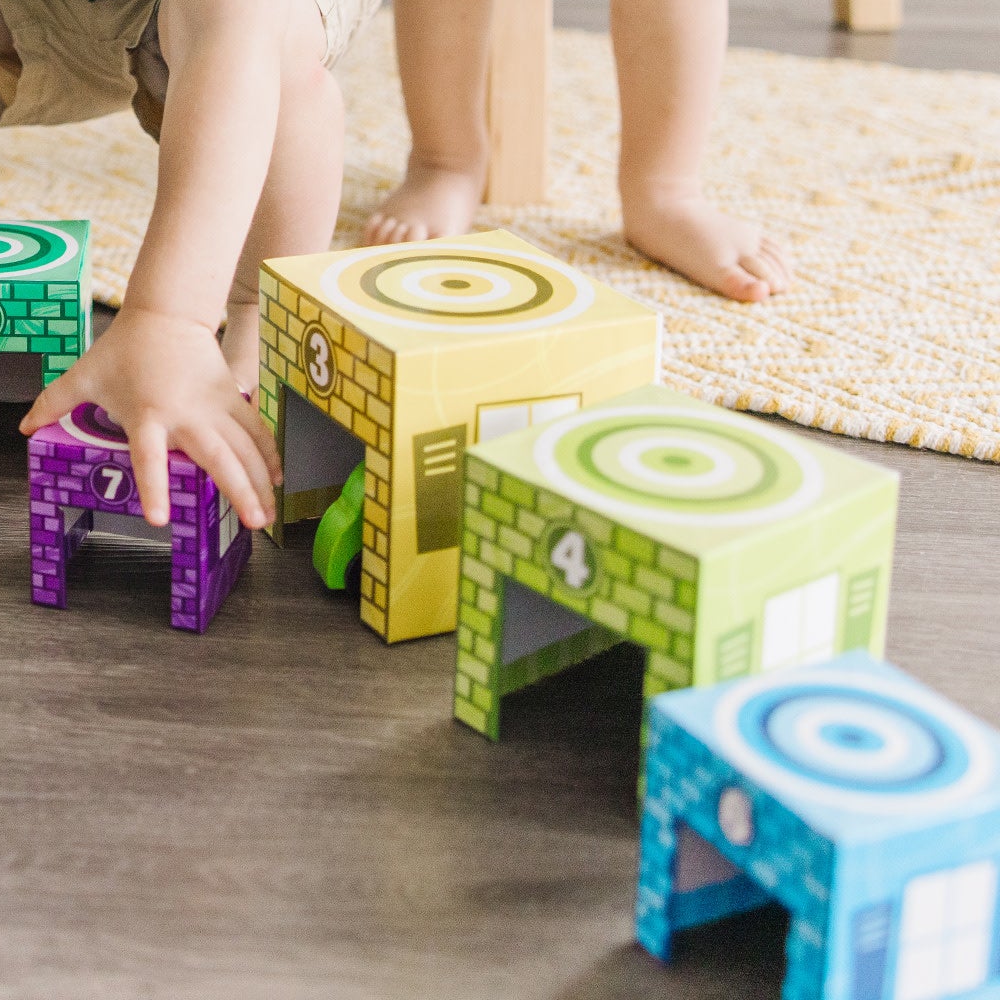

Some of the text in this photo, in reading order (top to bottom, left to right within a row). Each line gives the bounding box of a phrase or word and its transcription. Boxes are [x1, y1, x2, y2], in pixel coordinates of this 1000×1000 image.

[309, 334, 330, 386] 3
[101, 468, 124, 500] 7
[551, 531, 590, 588] 4
